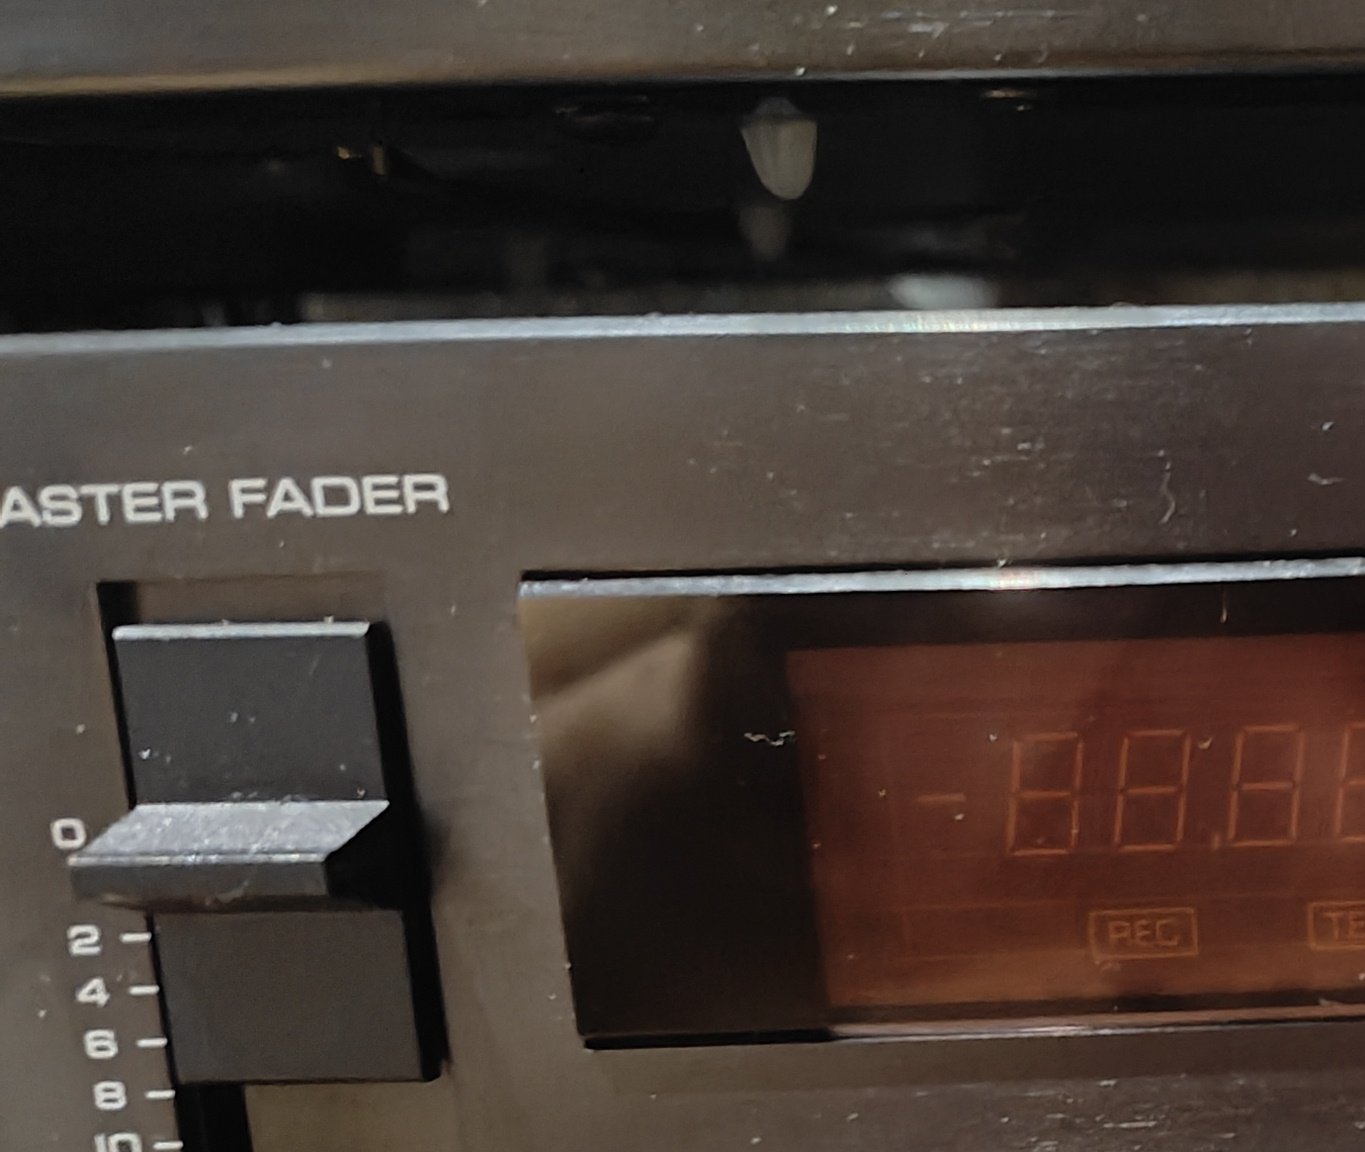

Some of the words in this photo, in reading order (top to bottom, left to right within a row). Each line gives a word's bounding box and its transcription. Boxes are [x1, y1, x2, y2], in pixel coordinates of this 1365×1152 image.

[228, 473, 450, 519] FADER
[67, 925, 100, 955] 2
[1108, 918, 1180, 947] REC
[75, 978, 109, 1007] 4
[85, 1030, 118, 1058] 6
[94, 1081, 128, 1109] 8
